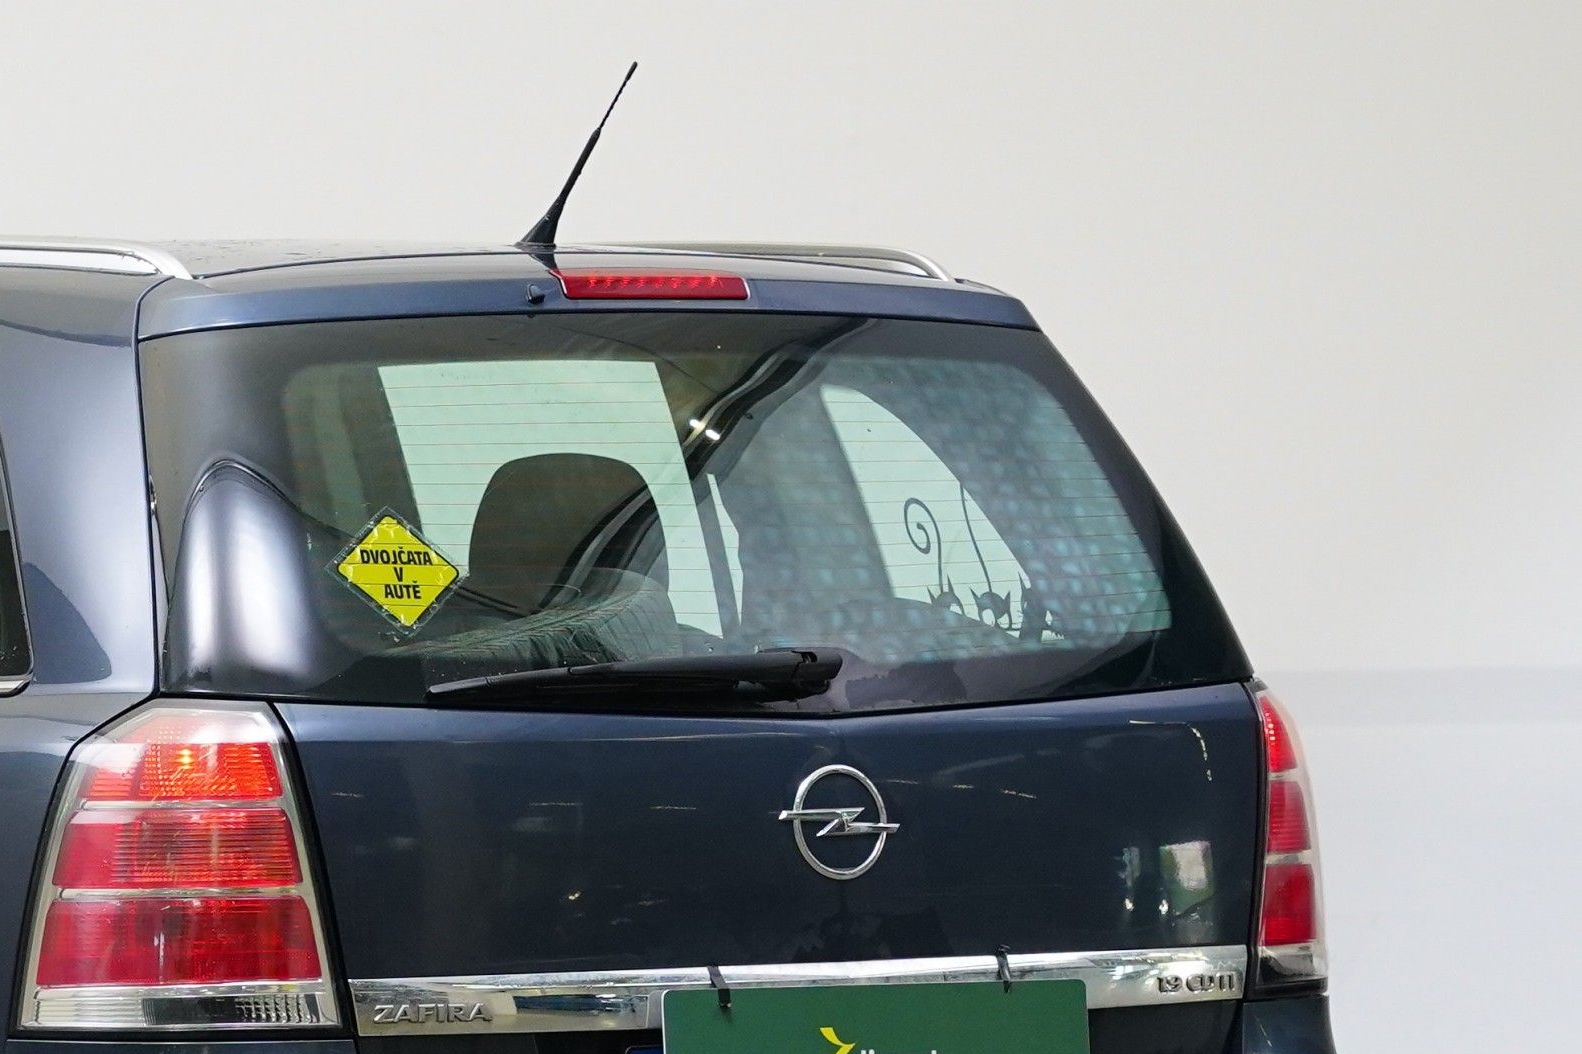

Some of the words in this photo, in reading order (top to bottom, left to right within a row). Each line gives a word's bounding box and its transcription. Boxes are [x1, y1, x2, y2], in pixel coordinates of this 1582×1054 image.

[359, 546, 432, 566] DVOJČATA
[394, 567, 403, 582] V
[384, 581, 421, 599] AUTĚ
[373, 1003, 492, 1024] ZAFIRA
